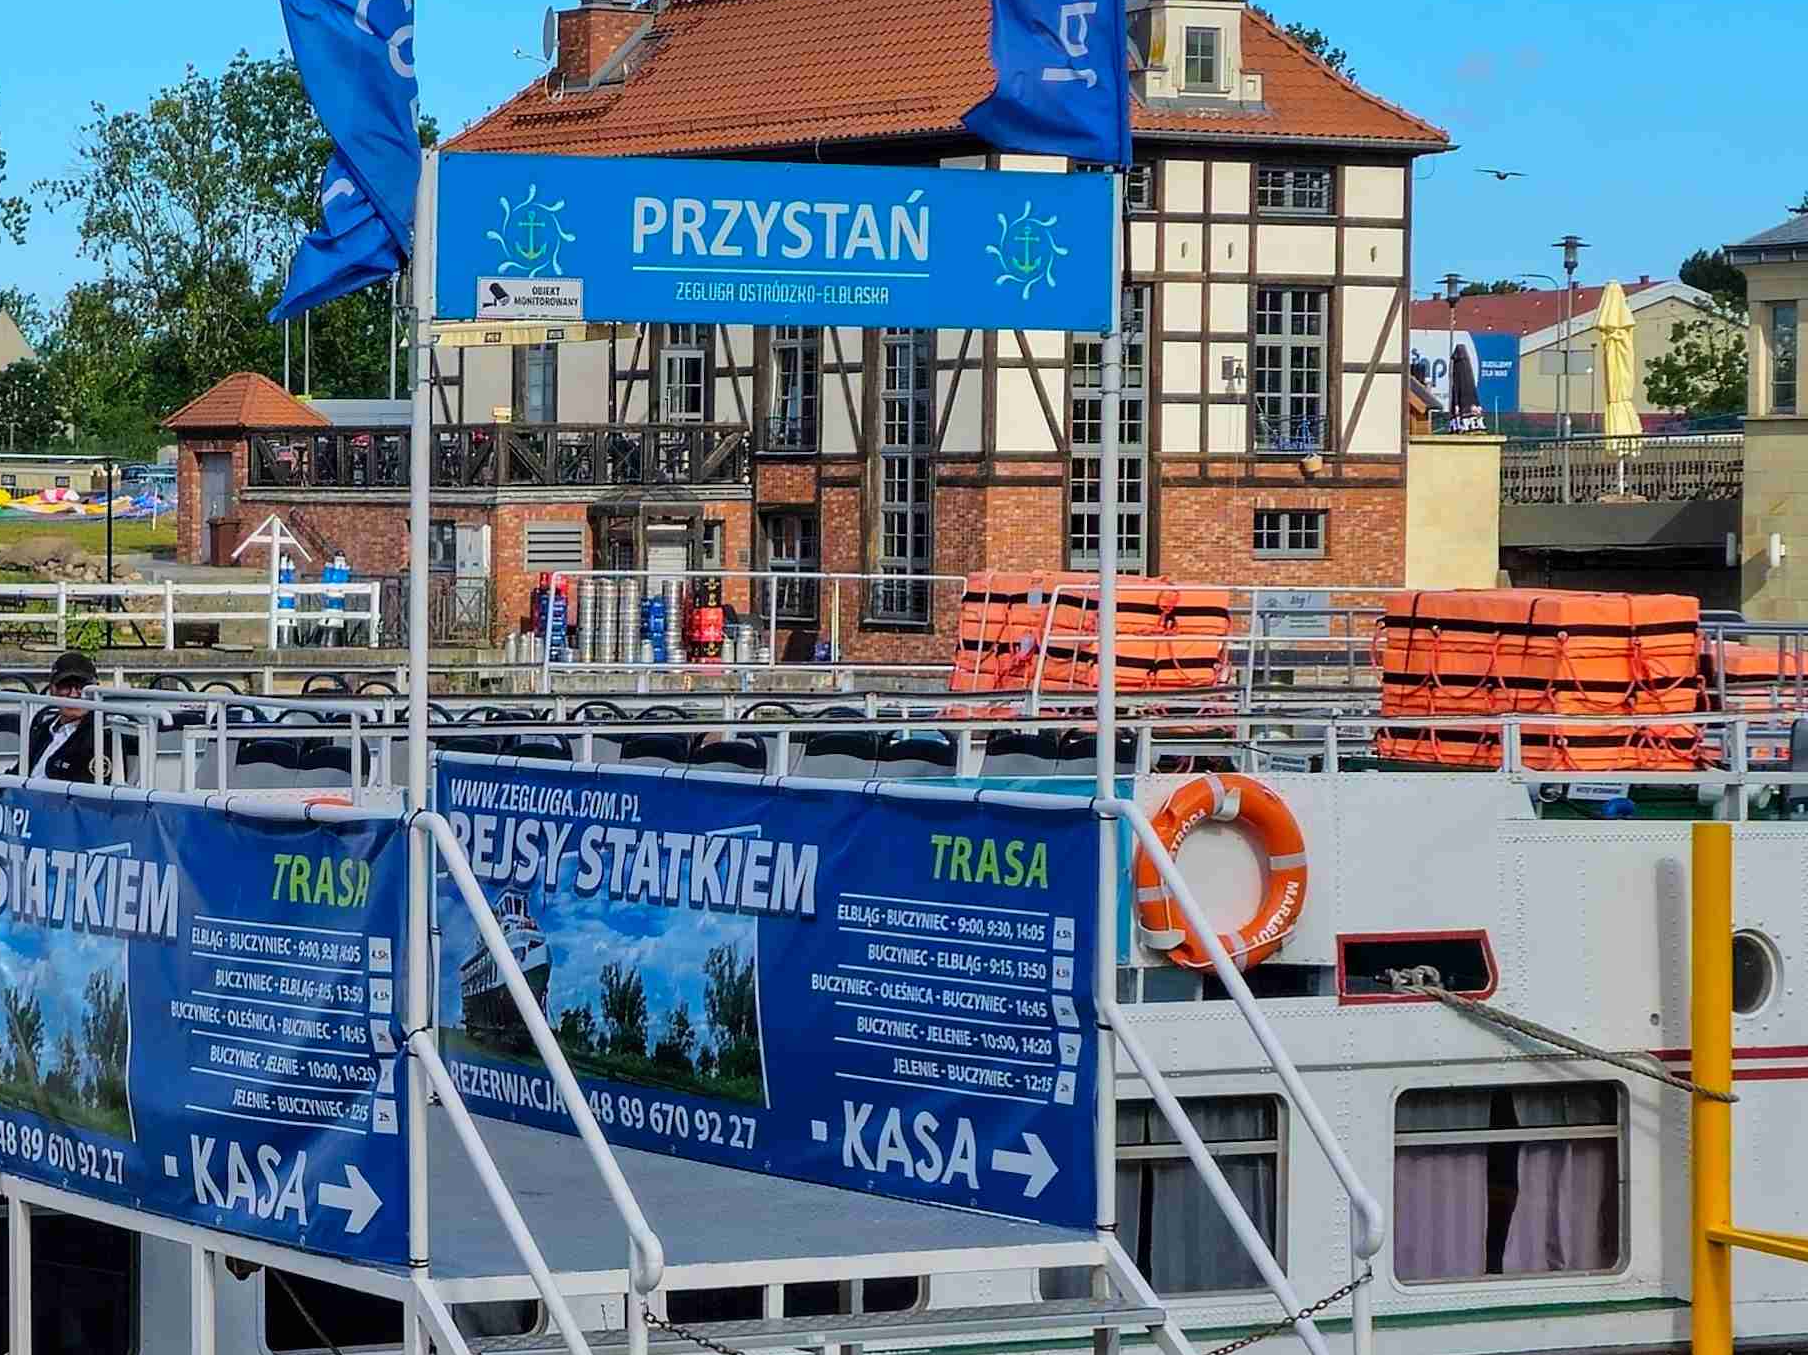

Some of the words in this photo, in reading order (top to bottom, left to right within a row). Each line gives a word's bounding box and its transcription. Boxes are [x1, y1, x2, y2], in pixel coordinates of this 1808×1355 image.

[632, 189, 930, 262] PRZYSTAŃ
[514, 297, 578, 306] MONITOROWANY
[531, 286, 560, 295] OBIEKT
[450, 778, 642, 823] WWW.ZEGLUGA.COM.PL
[272, 854, 371, 909] TRASA
[449, 810, 574, 885] REJSY
[575, 824, 819, 915] STATKIEM
[930, 834, 1050, 889] TRASA
[837, 903, 880, 927] ELBLĄG
[886, 908, 949, 931] BUCZYNIEC
[1016, 923, 1045, 941] 14:05
[1253, 880, 1299, 946] MARABUT
[230, 933, 291, 953] BUCZYNIEC
[868, 944, 928, 966] BUCZYNIEC
[937, 952, 981, 976] ELBLĄG
[1017, 961, 1046, 980] 13:50
[215, 969, 273, 992] BUCZYNIEC
[811, 973, 873, 997] BUCZYNIEC
[880, 981, 933, 1005] OLEŚNICA
[942, 990, 1007, 1014] BUCZYNIEC
[1015, 1000, 1048, 1018] 14:45
[171, 1000, 221, 1025] BUCZYNIEC
[340, 1025, 367, 1044] 14:45
[856, 1016, 919, 1040] BUCZYNIEC
[926, 1026, 972, 1046] JELENIE
[1021, 1036, 1052, 1055] 14:20
[210, 1044, 261, 1070] BUCZYNIEC
[892, 1058, 940, 1078] JELENIE
[947, 1064, 1014, 1088] BUCZYNIEC
[1023, 1074, 1053, 1092] 12:15
[277, 1095, 345, 1118] BUCZYNIEC
[449, 1059, 569, 1115] REZERWACJA
[588, 1089, 615, 1125] 48
[619, 1094, 645, 1130] 89
[649, 1101, 689, 1139] 670
[694, 1108, 724, 1145] 92
[729, 1114, 757, 1151] 27
[20, 1128, 44, 1163] 89
[79, 1145, 102, 1178] 92
[102, 1150, 124, 1185] 27
[842, 1099, 980, 1190] KASA
[190, 1133, 308, 1226] KASA
